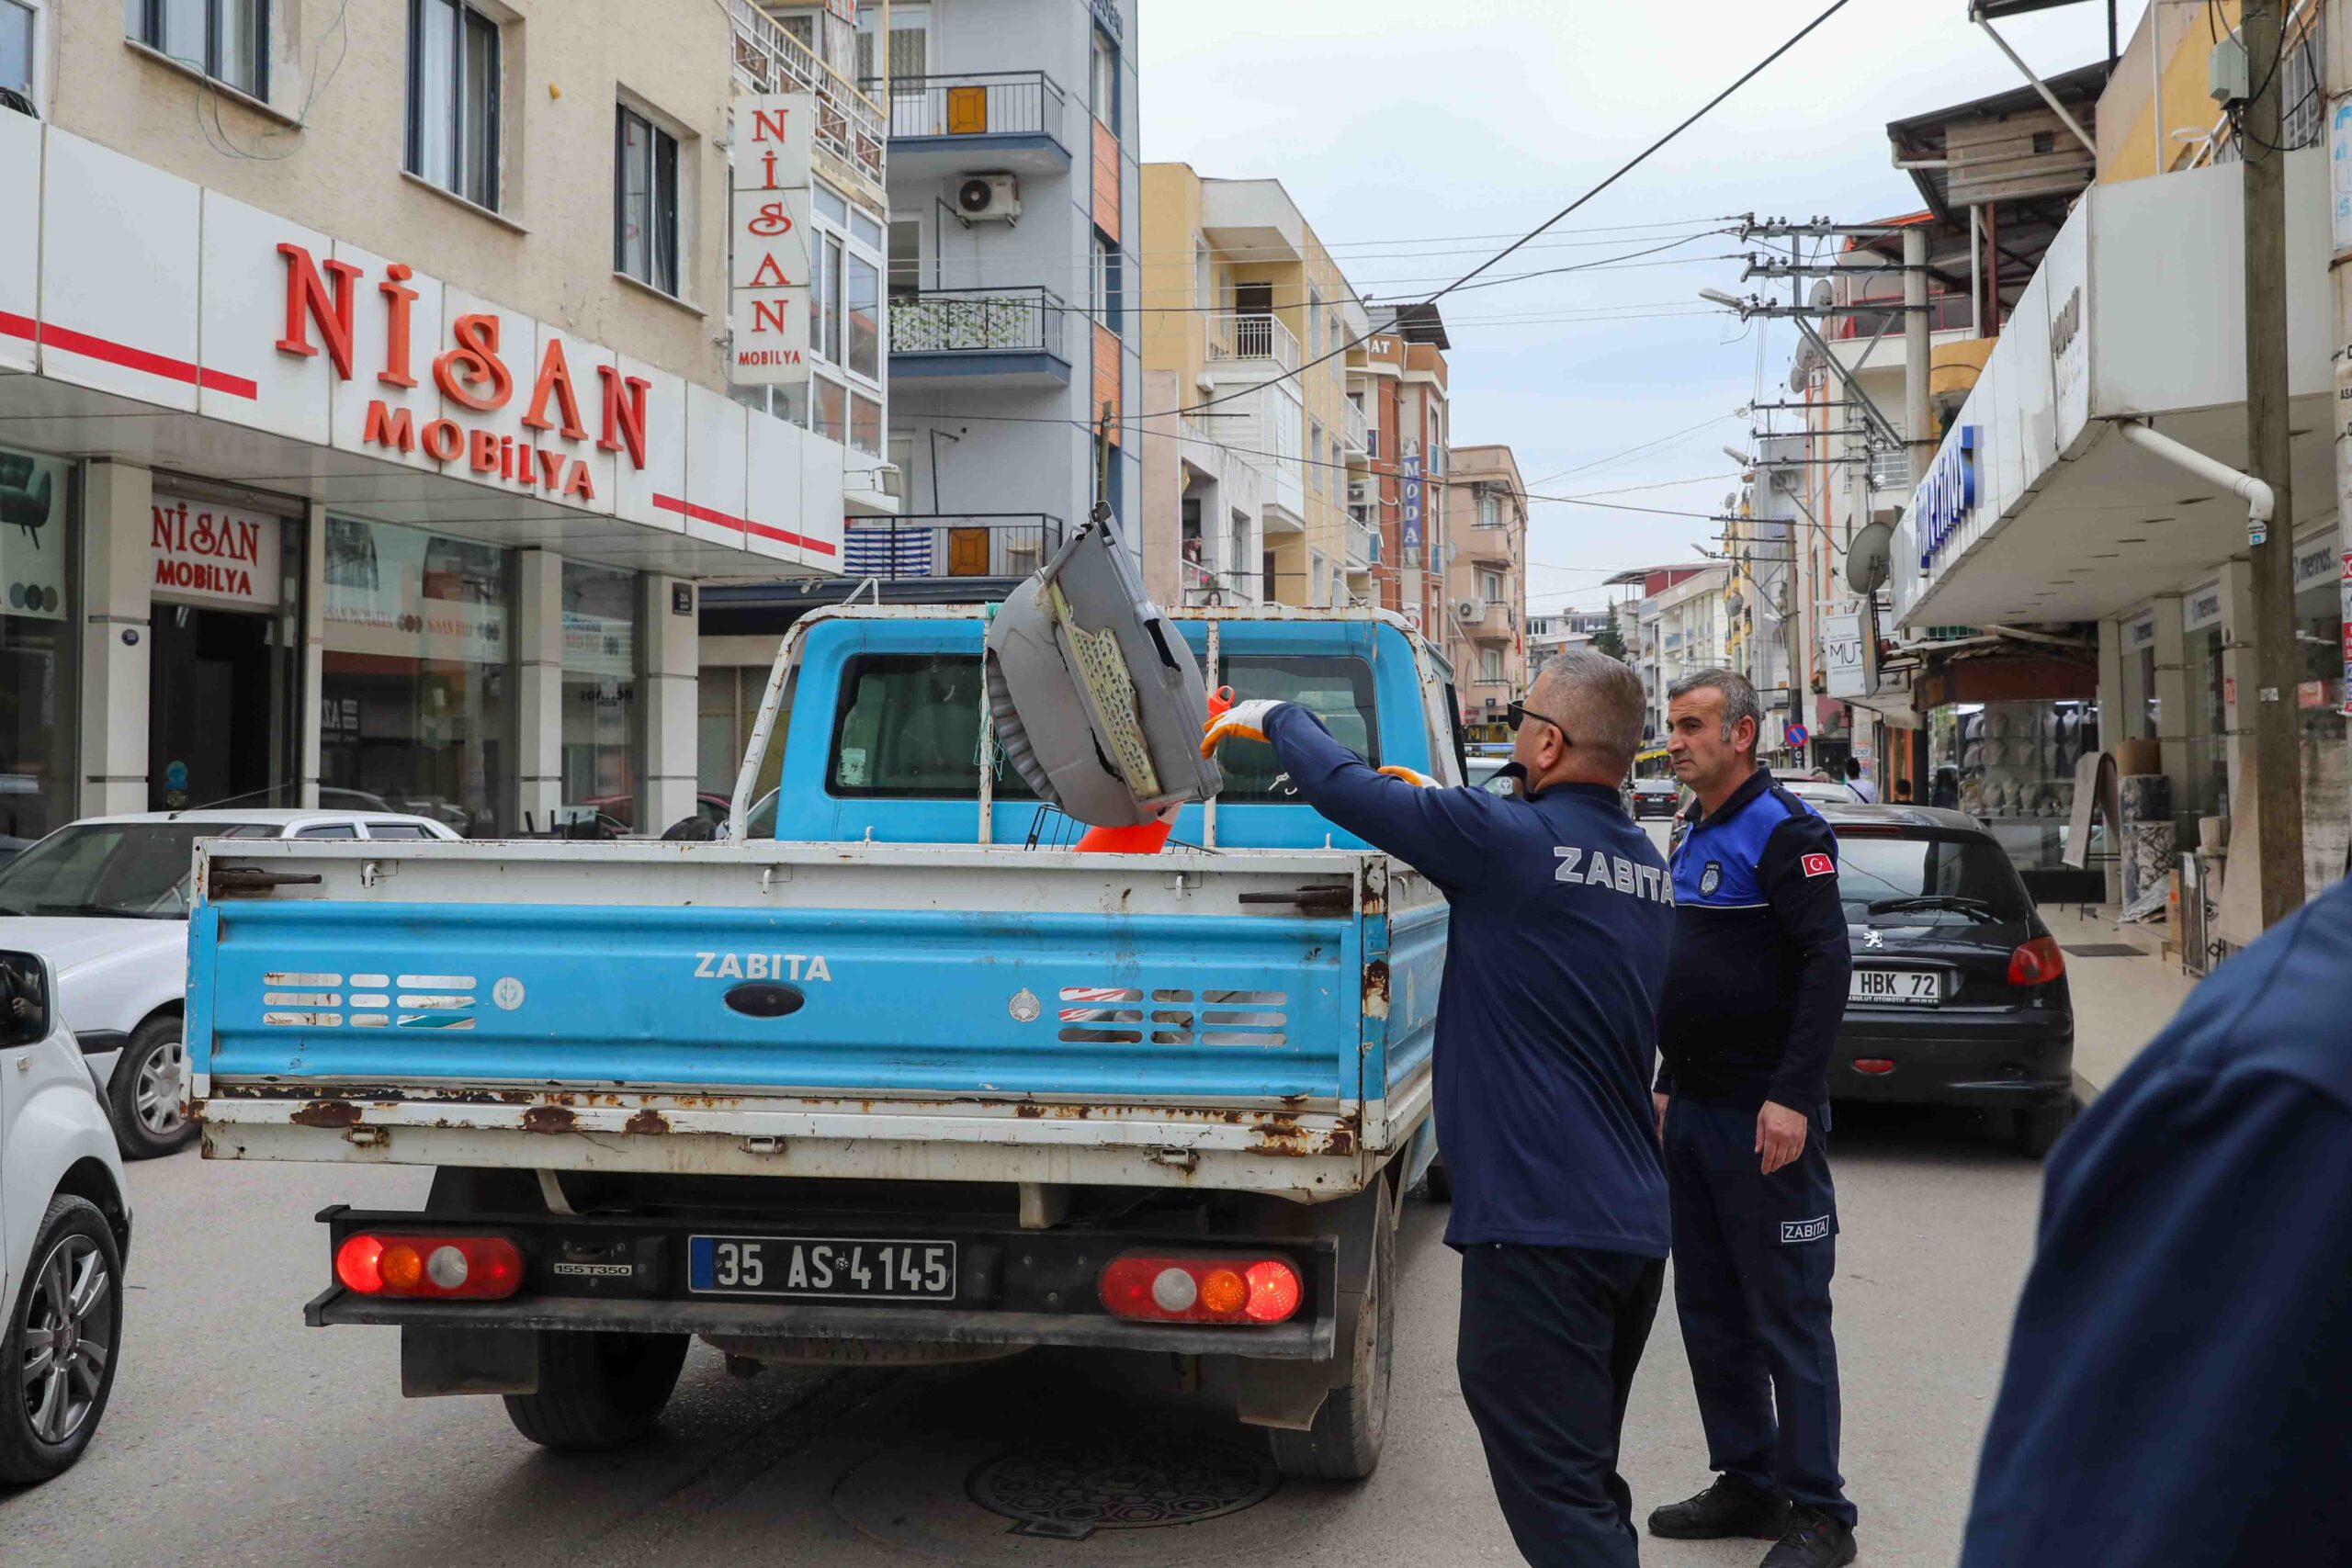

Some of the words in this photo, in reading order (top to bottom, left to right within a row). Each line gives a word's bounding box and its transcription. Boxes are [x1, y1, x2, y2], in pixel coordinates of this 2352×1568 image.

[1404, 461, 1419, 544] MODA
[1554, 846, 1675, 908] ZABITA
[694, 952, 831, 982] ZABITA
[1860, 973, 1896, 994] HBK
[1911, 975, 1935, 996] 72
[1785, 1221, 1826, 1238] ZABITA
[718, 1244, 763, 1286] 35
[787, 1245, 833, 1289] AS
[851, 1247, 947, 1292] 4145
